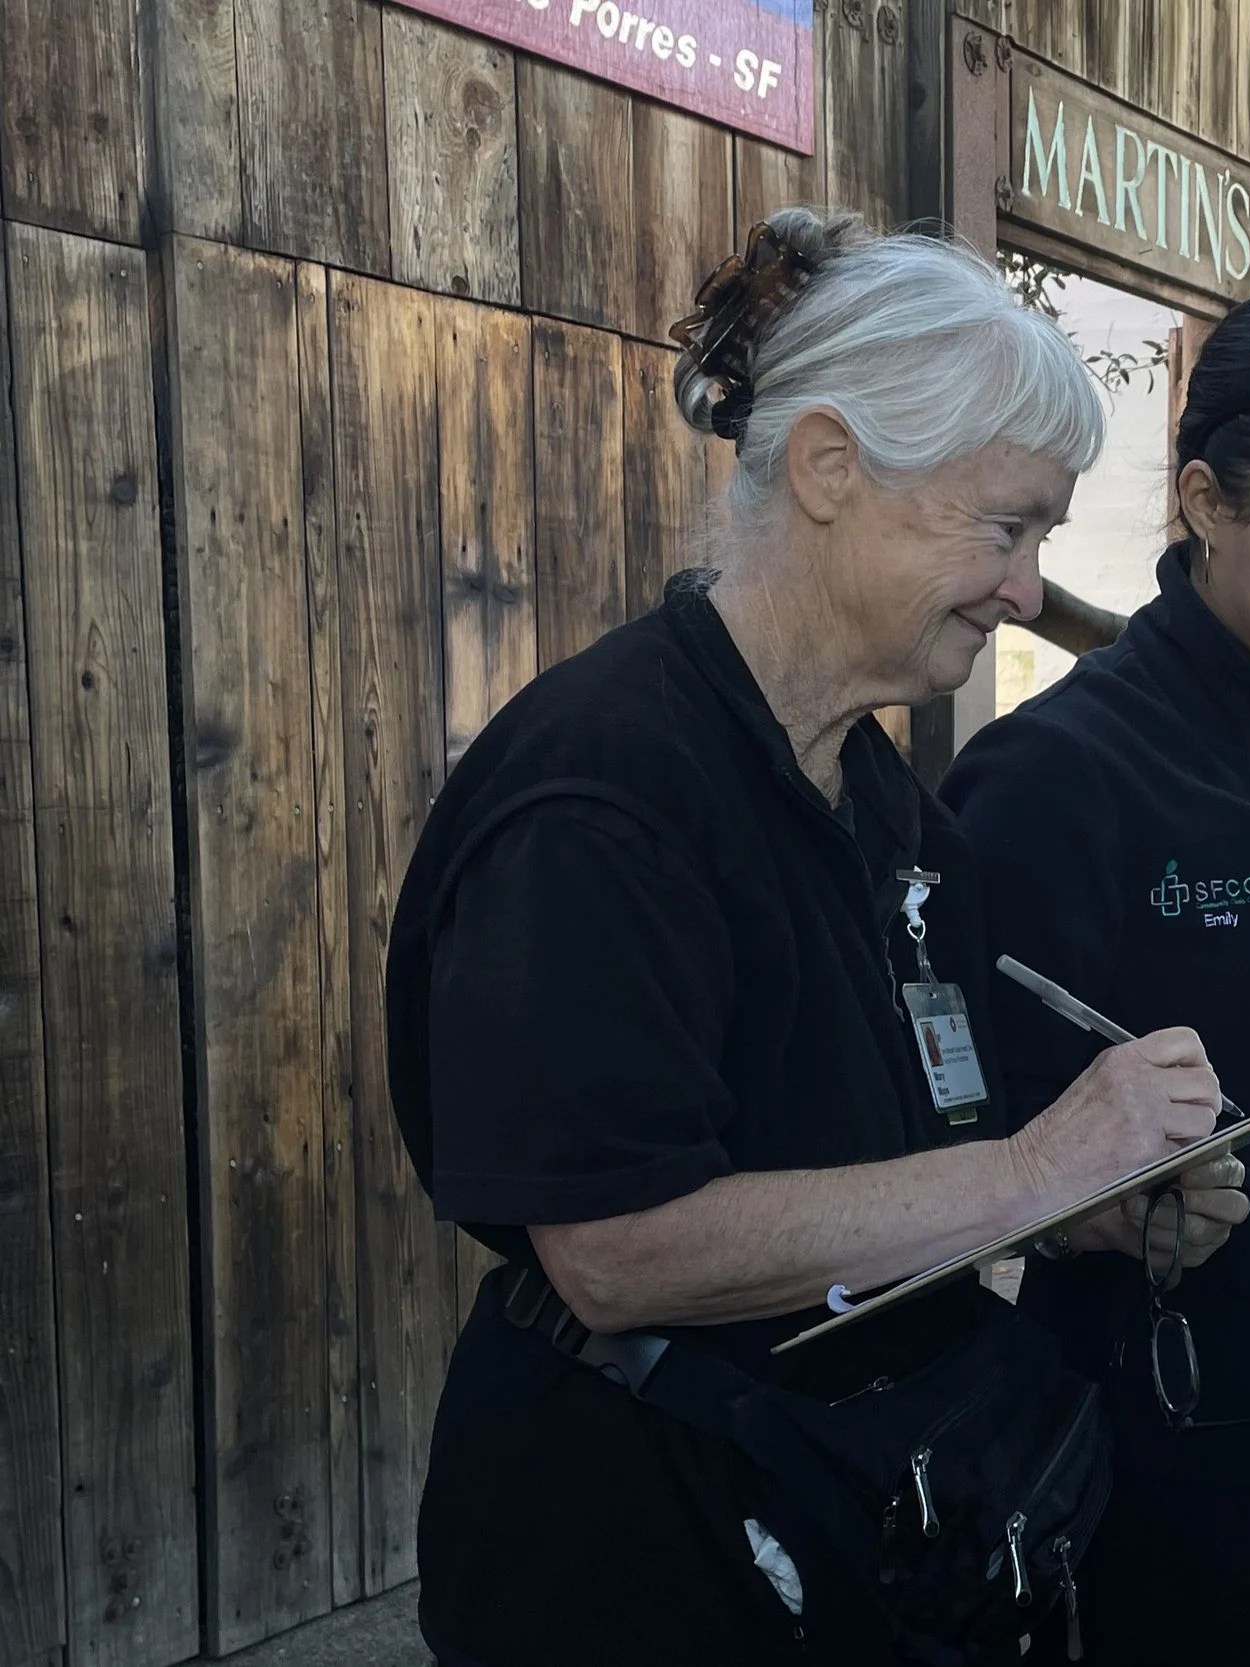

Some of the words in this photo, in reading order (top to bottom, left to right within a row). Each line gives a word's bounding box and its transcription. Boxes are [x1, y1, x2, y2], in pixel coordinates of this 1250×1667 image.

[569, 0, 698, 68] Porres
[733, 49, 782, 99] SF
[1204, 911, 1239, 928] Emily
